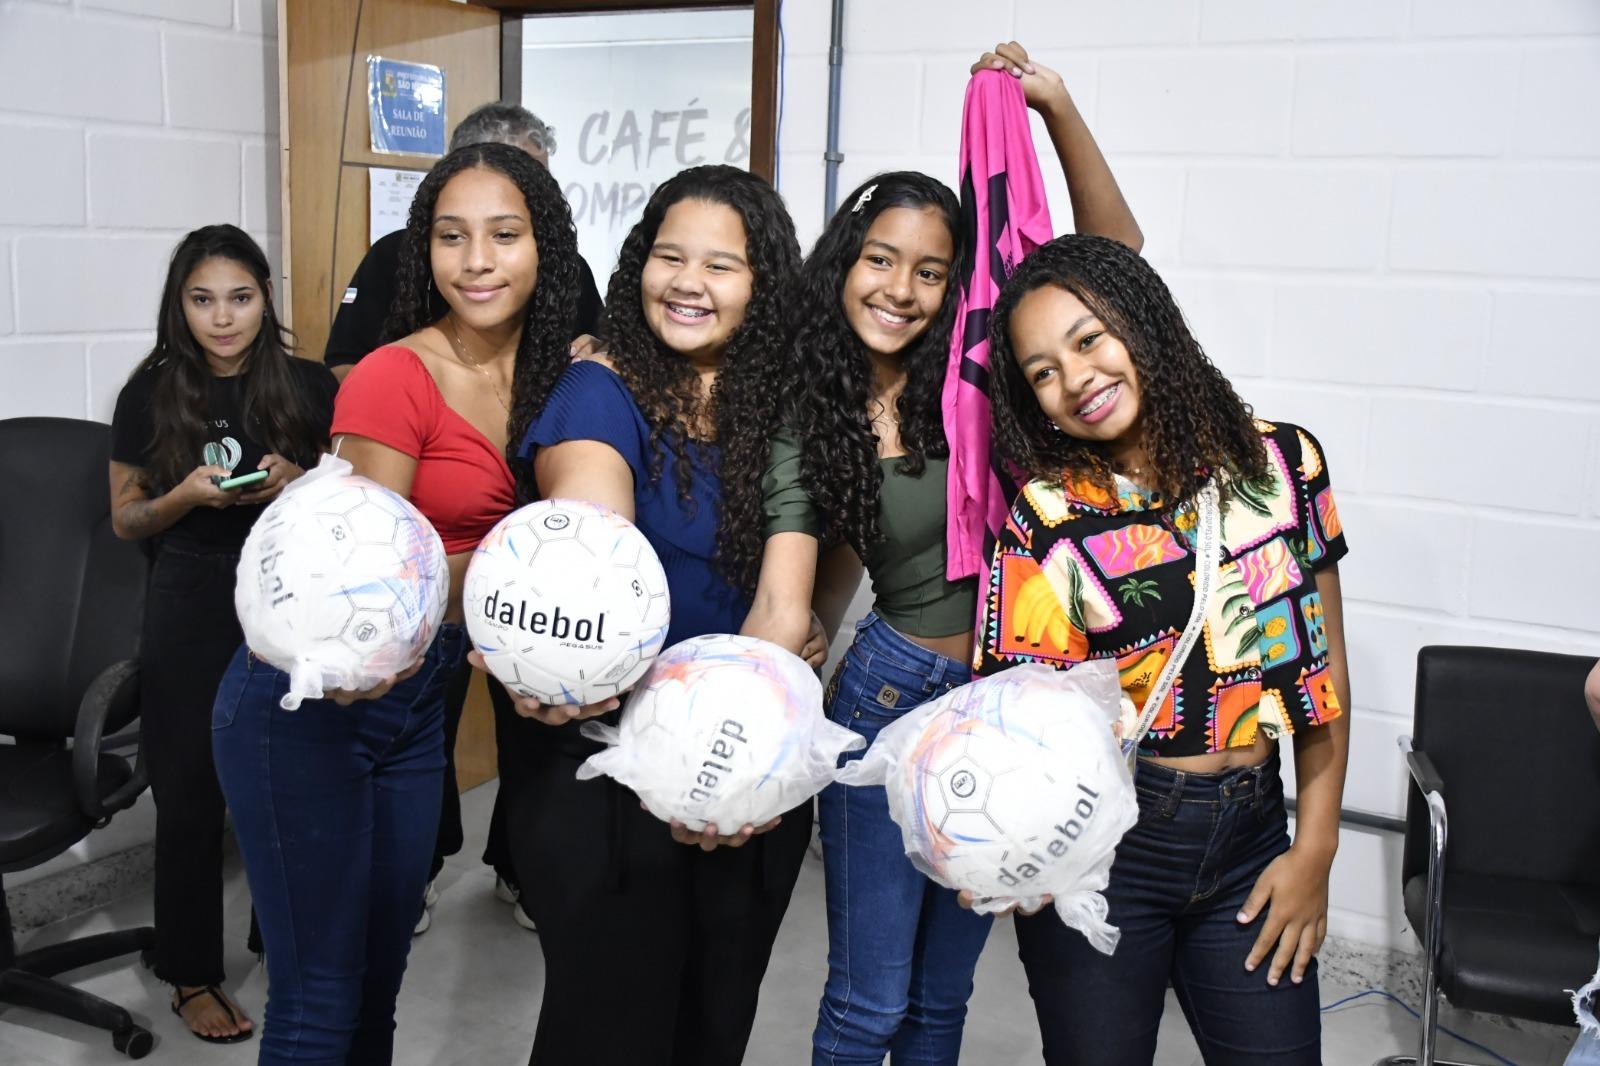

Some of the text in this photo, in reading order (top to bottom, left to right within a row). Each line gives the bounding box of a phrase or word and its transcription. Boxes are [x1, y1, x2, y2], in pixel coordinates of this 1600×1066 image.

[392, 108, 424, 122] SALA DE
[391, 125, 427, 139] REUNIÃO
[578, 98, 750, 171] CAFÉ &
[563, 181, 657, 231] OMP
[1203, 561, 1211, 593] COLORIDO
[484, 589, 605, 643] dalebol
[1194, 612, 1203, 623] SOL
[1200, 593, 1208, 611] PELO
[560, 641, 603, 650] PEGASUS
[1174, 632, 1193, 664] COLORIDO
[1165, 664, 1177, 681] PELO
[684, 718, 748, 822] daleb
[998, 783, 1100, 887] dalebol
